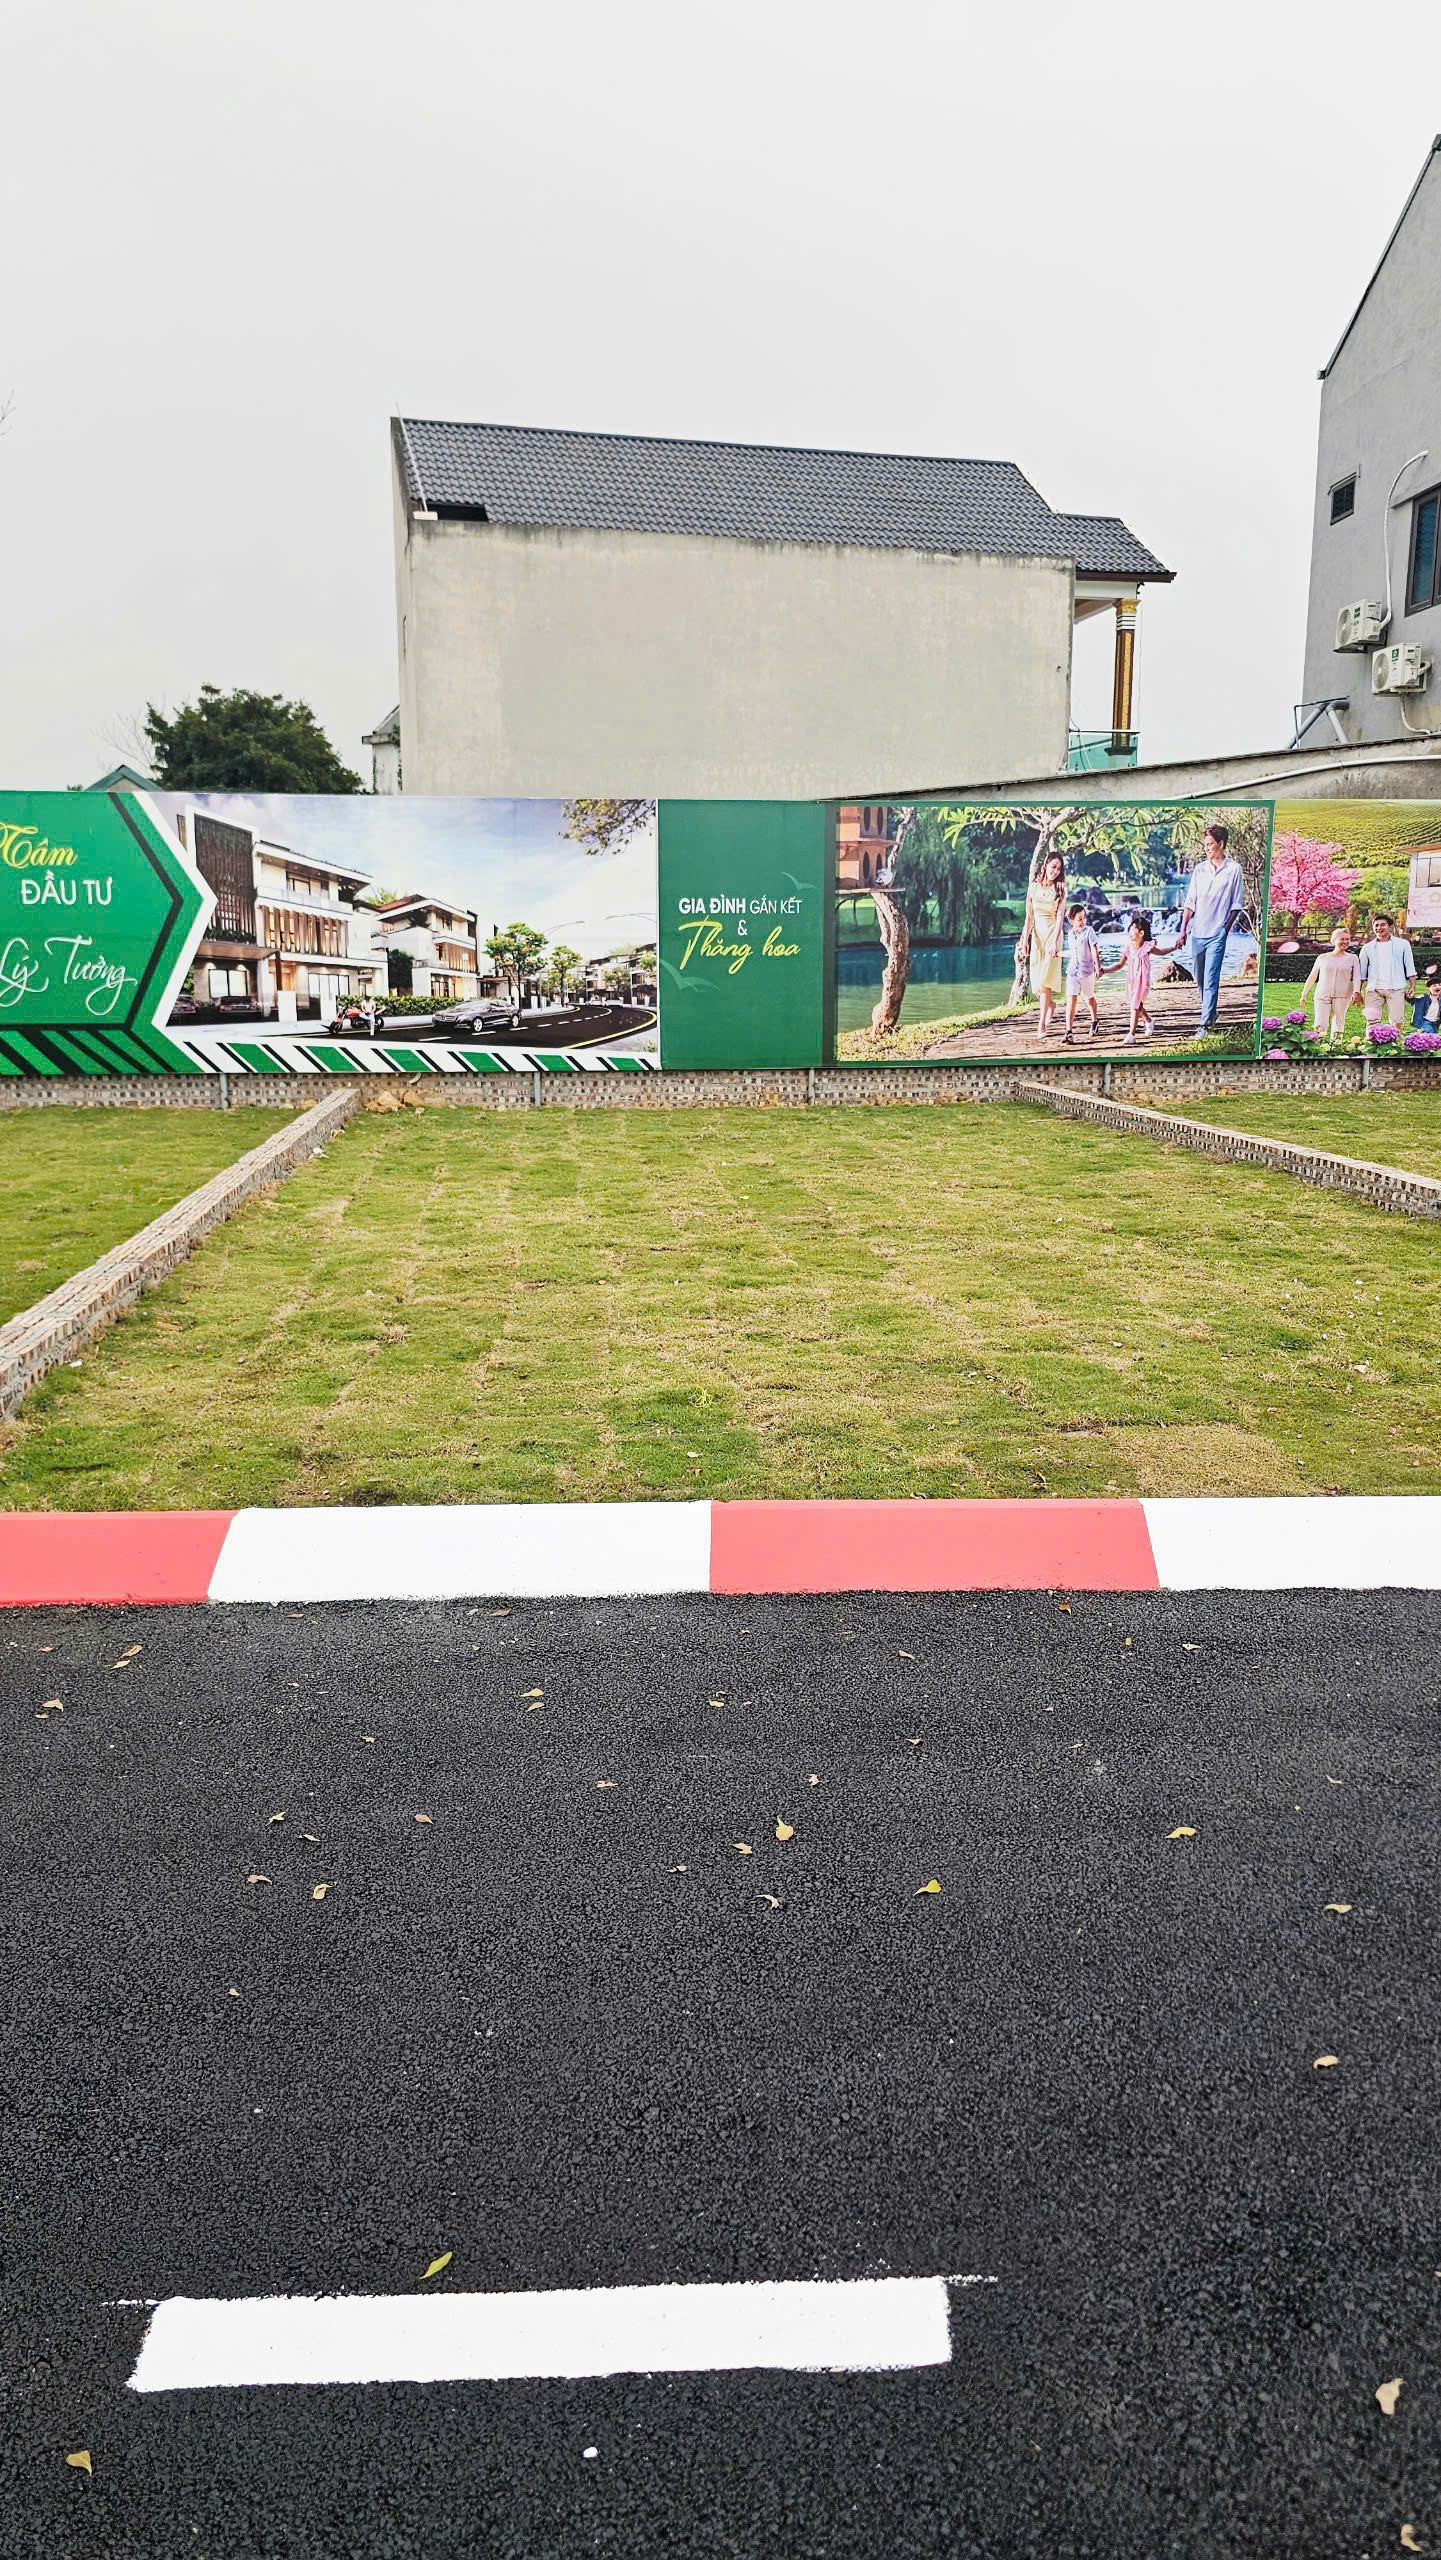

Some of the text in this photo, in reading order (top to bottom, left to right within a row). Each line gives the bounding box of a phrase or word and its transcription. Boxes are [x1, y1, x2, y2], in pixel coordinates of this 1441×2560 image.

[0, 822, 78, 869] Tâm
[21, 869, 113, 905] ĐẦU TƯ
[678, 893, 802, 915] GIA ĐÌNH GẮN KẾT
[678, 915, 801, 975] Thăng hoa
[737, 919, 748, 936] &
[0, 934, 138, 1016] Lý Tưởng
